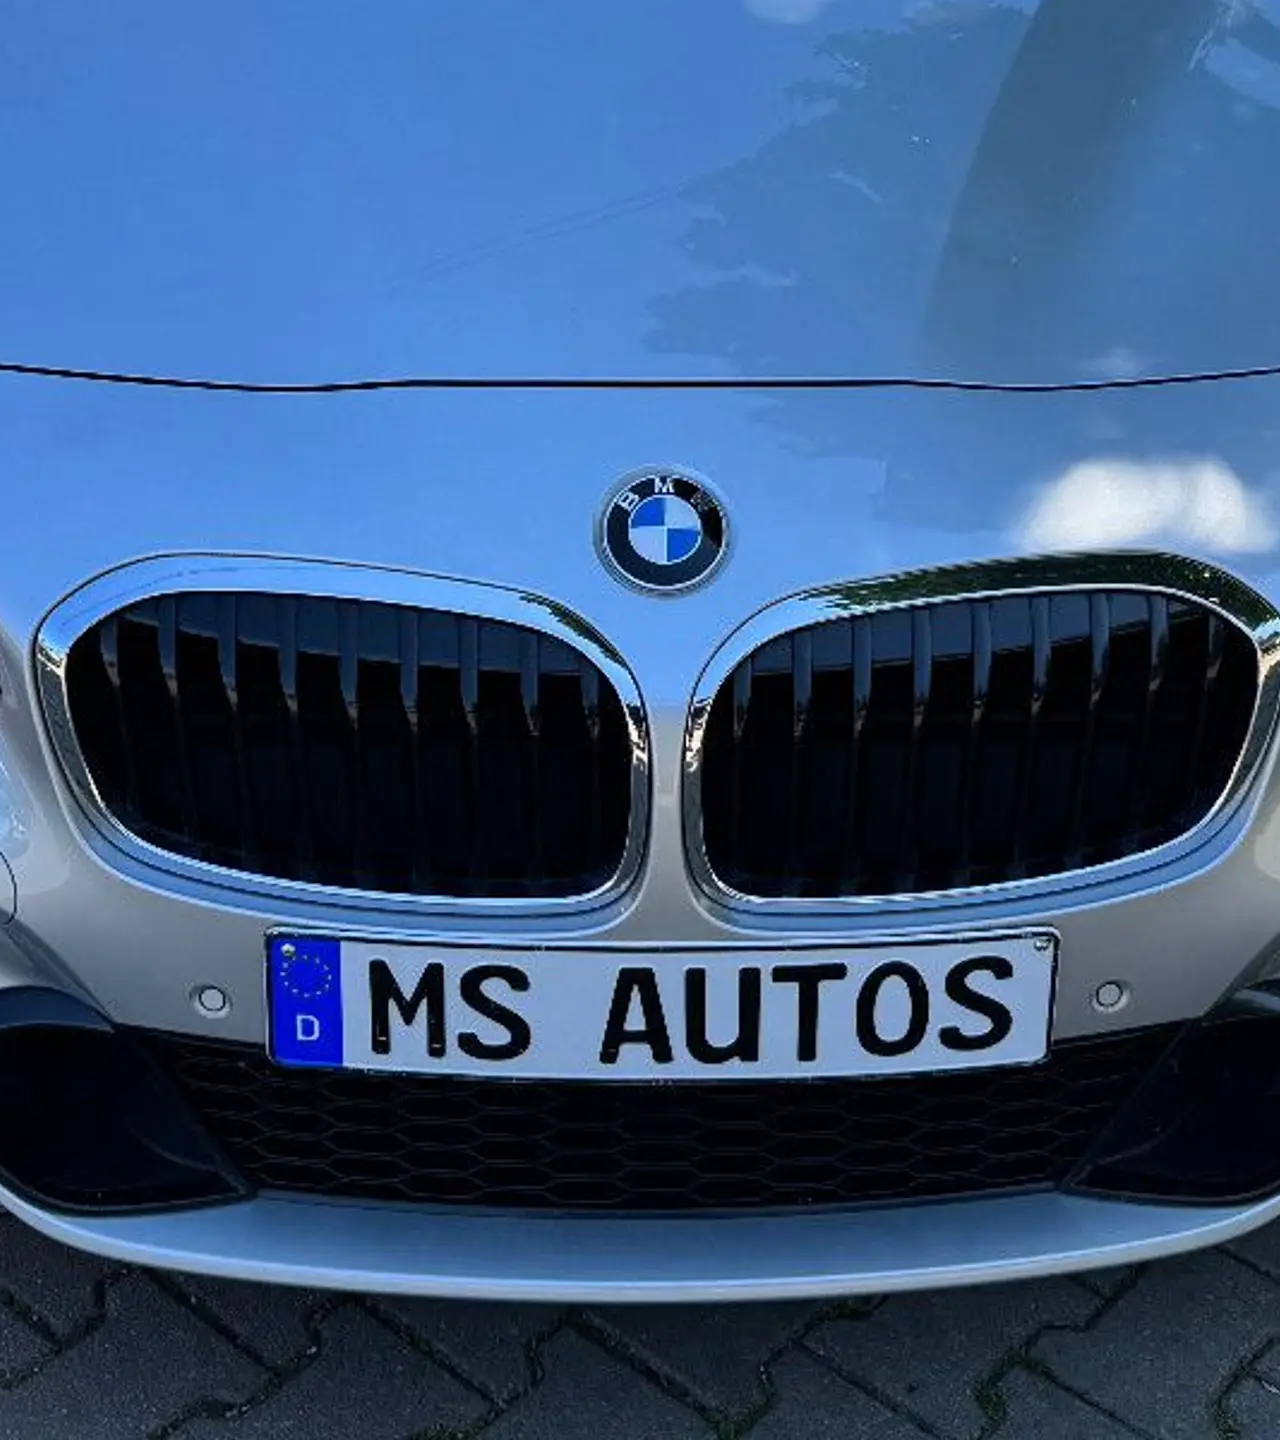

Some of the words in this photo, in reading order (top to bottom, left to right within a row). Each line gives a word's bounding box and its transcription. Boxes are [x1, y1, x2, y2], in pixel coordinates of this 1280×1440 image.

[296, 1014, 320, 1041] D
[367, 959, 532, 1061] MS
[598, 956, 1015, 1065] AUTOS
